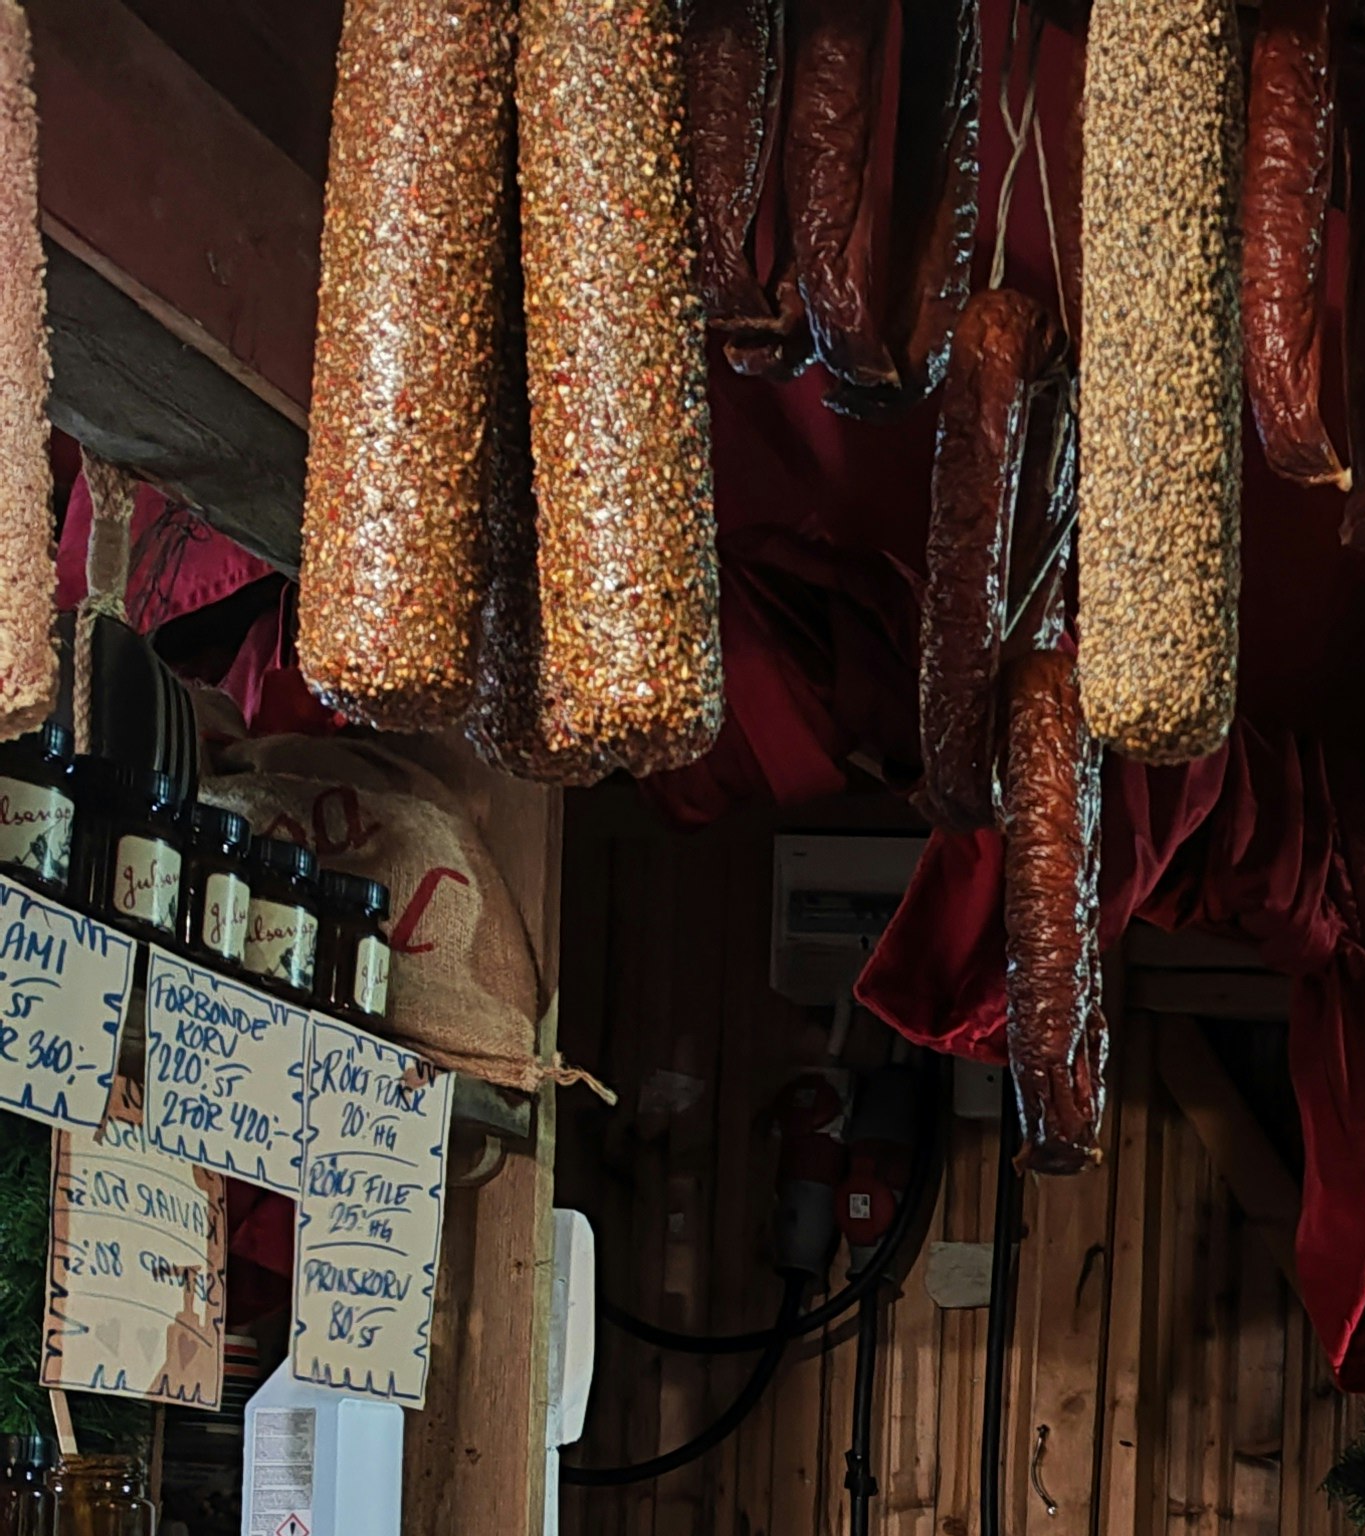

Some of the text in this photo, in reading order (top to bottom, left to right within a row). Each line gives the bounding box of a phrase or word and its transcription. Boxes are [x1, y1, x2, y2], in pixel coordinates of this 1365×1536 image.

[176, 1020, 238, 1058] KORV
[321, 1047, 372, 1096] RÖKT
[308, 1156, 367, 1199] RÖKT
[304, 1258, 413, 1301] PRINSKORV
